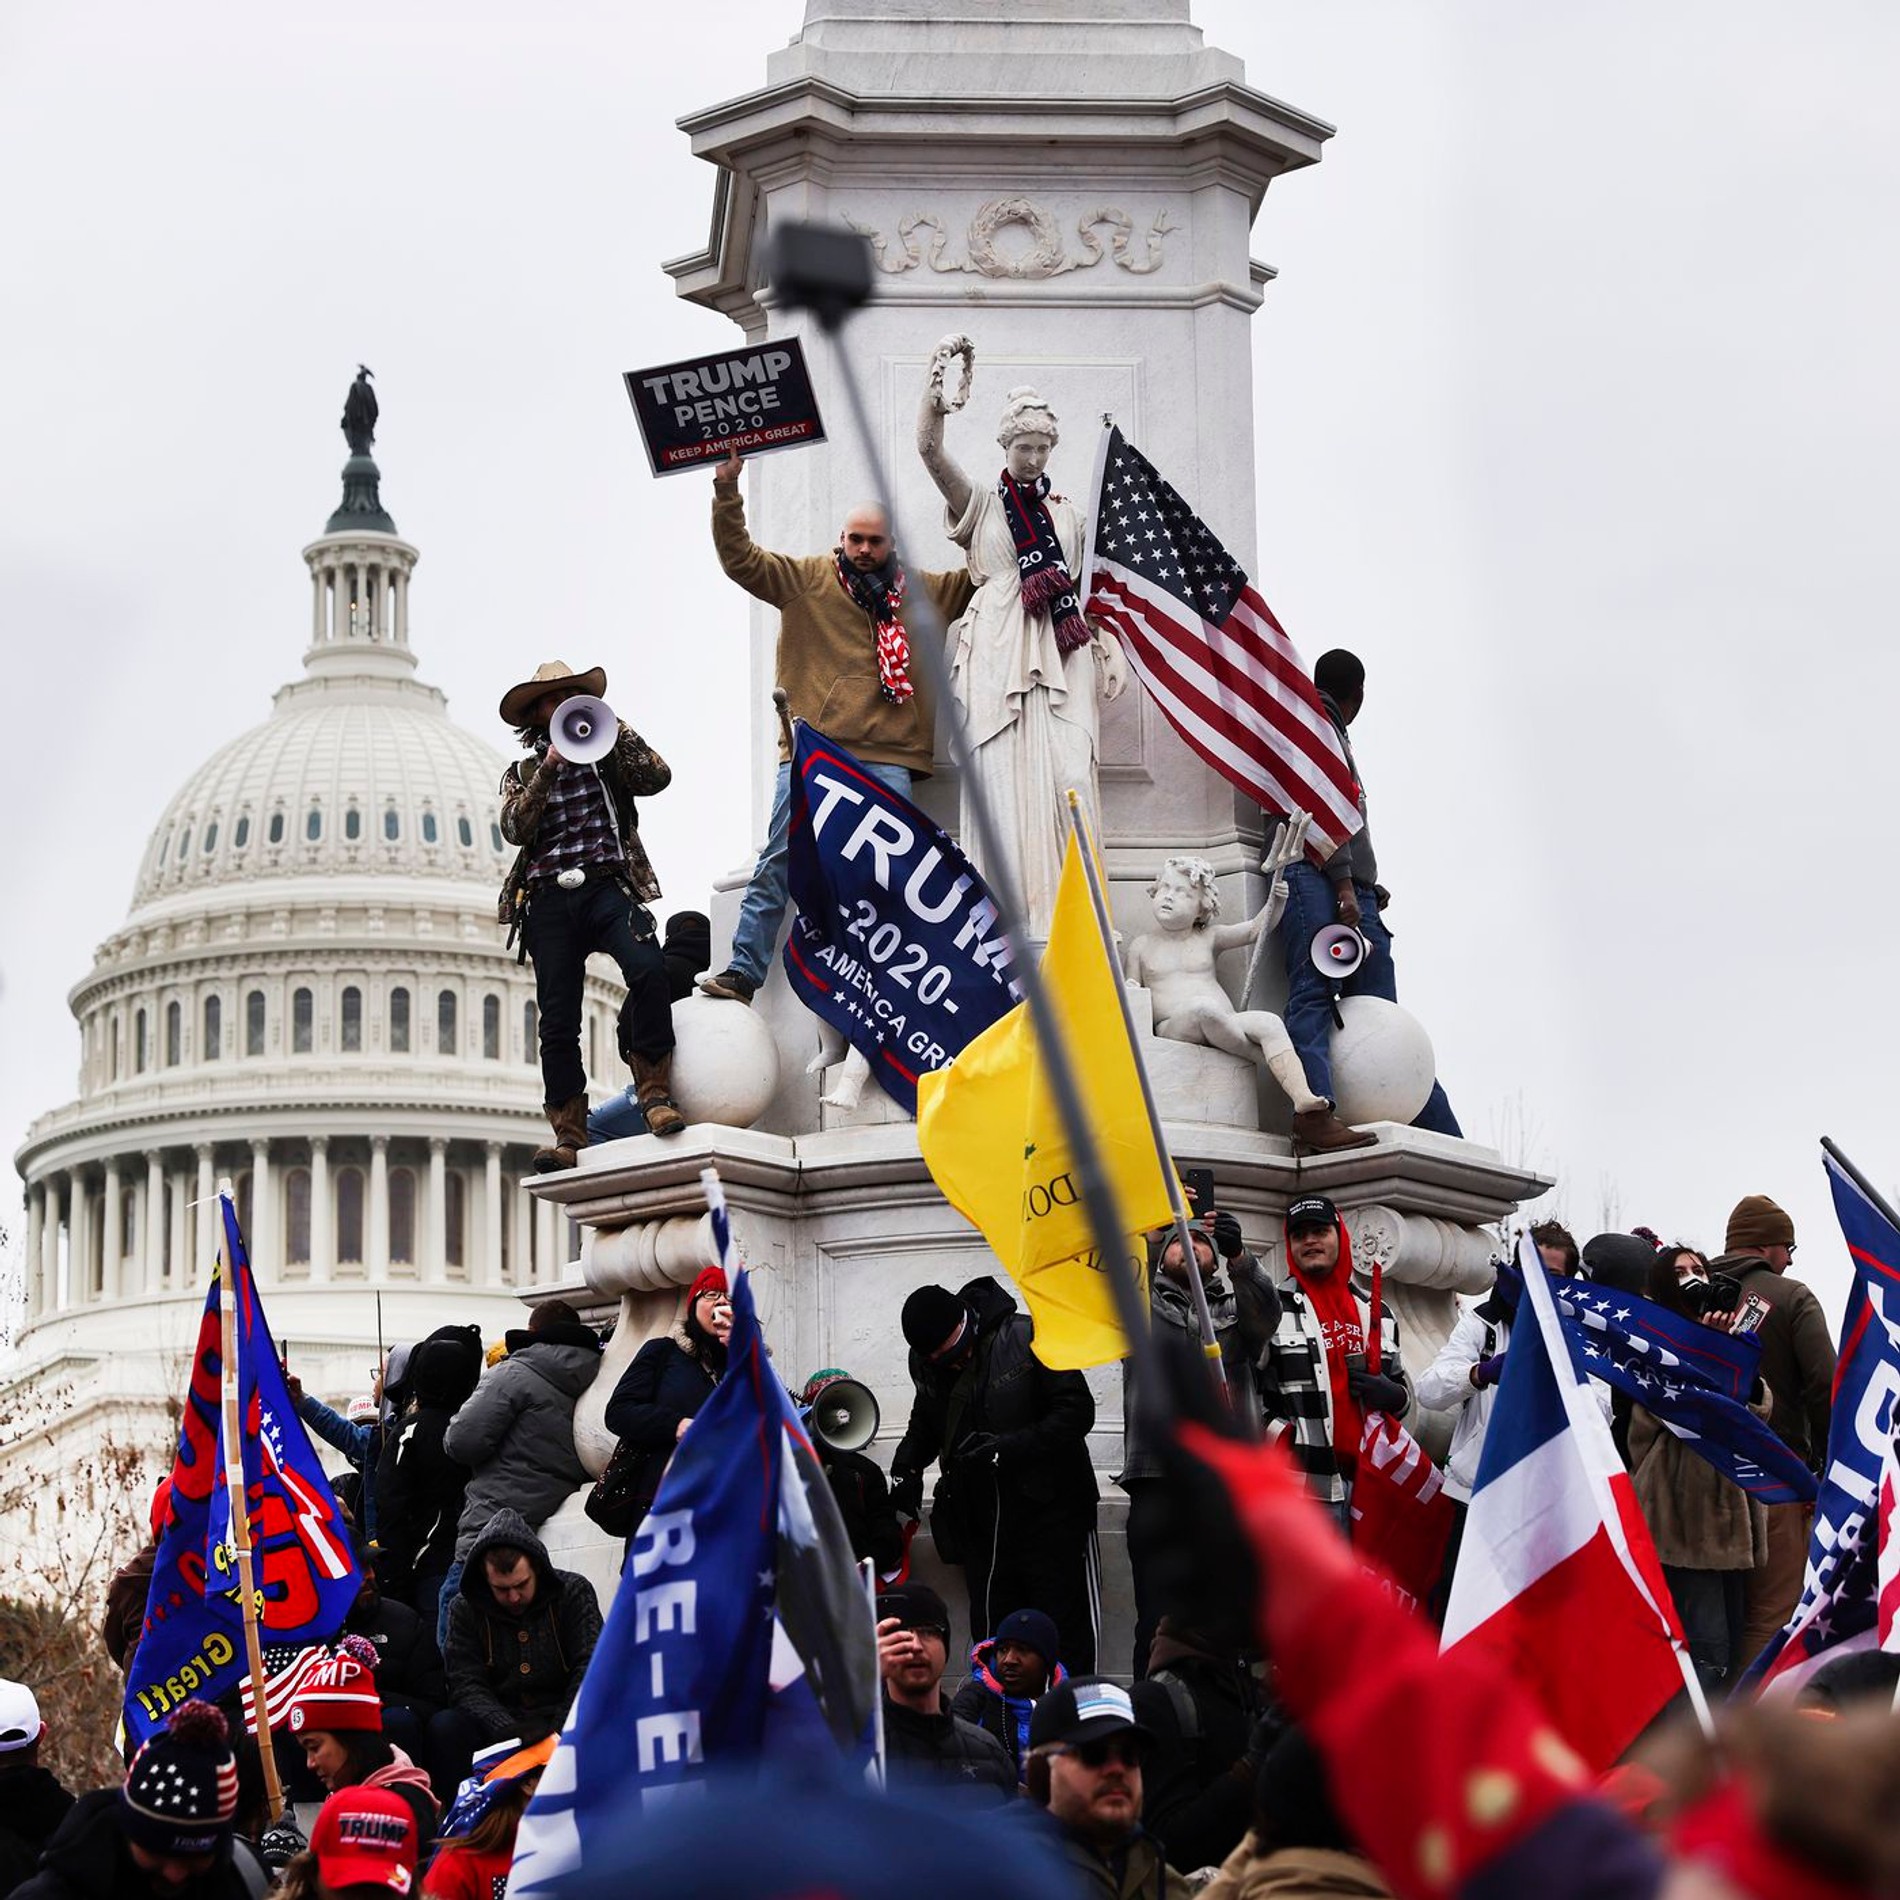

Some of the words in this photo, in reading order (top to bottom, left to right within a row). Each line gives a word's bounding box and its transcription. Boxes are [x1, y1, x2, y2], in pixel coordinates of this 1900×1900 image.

[642, 350, 791, 406] TRUMP
[673, 385, 781, 427] PENCE
[669, 447, 702, 461] KEEP
[705, 432, 763, 455] AMERICA
[765, 423, 807, 441] GREAT
[701, 414, 764, 439] 2020
[813, 773, 1029, 1005] TRUM
[300, 1661, 361, 1688] UMP
[339, 1818, 409, 1843] TRUMP
